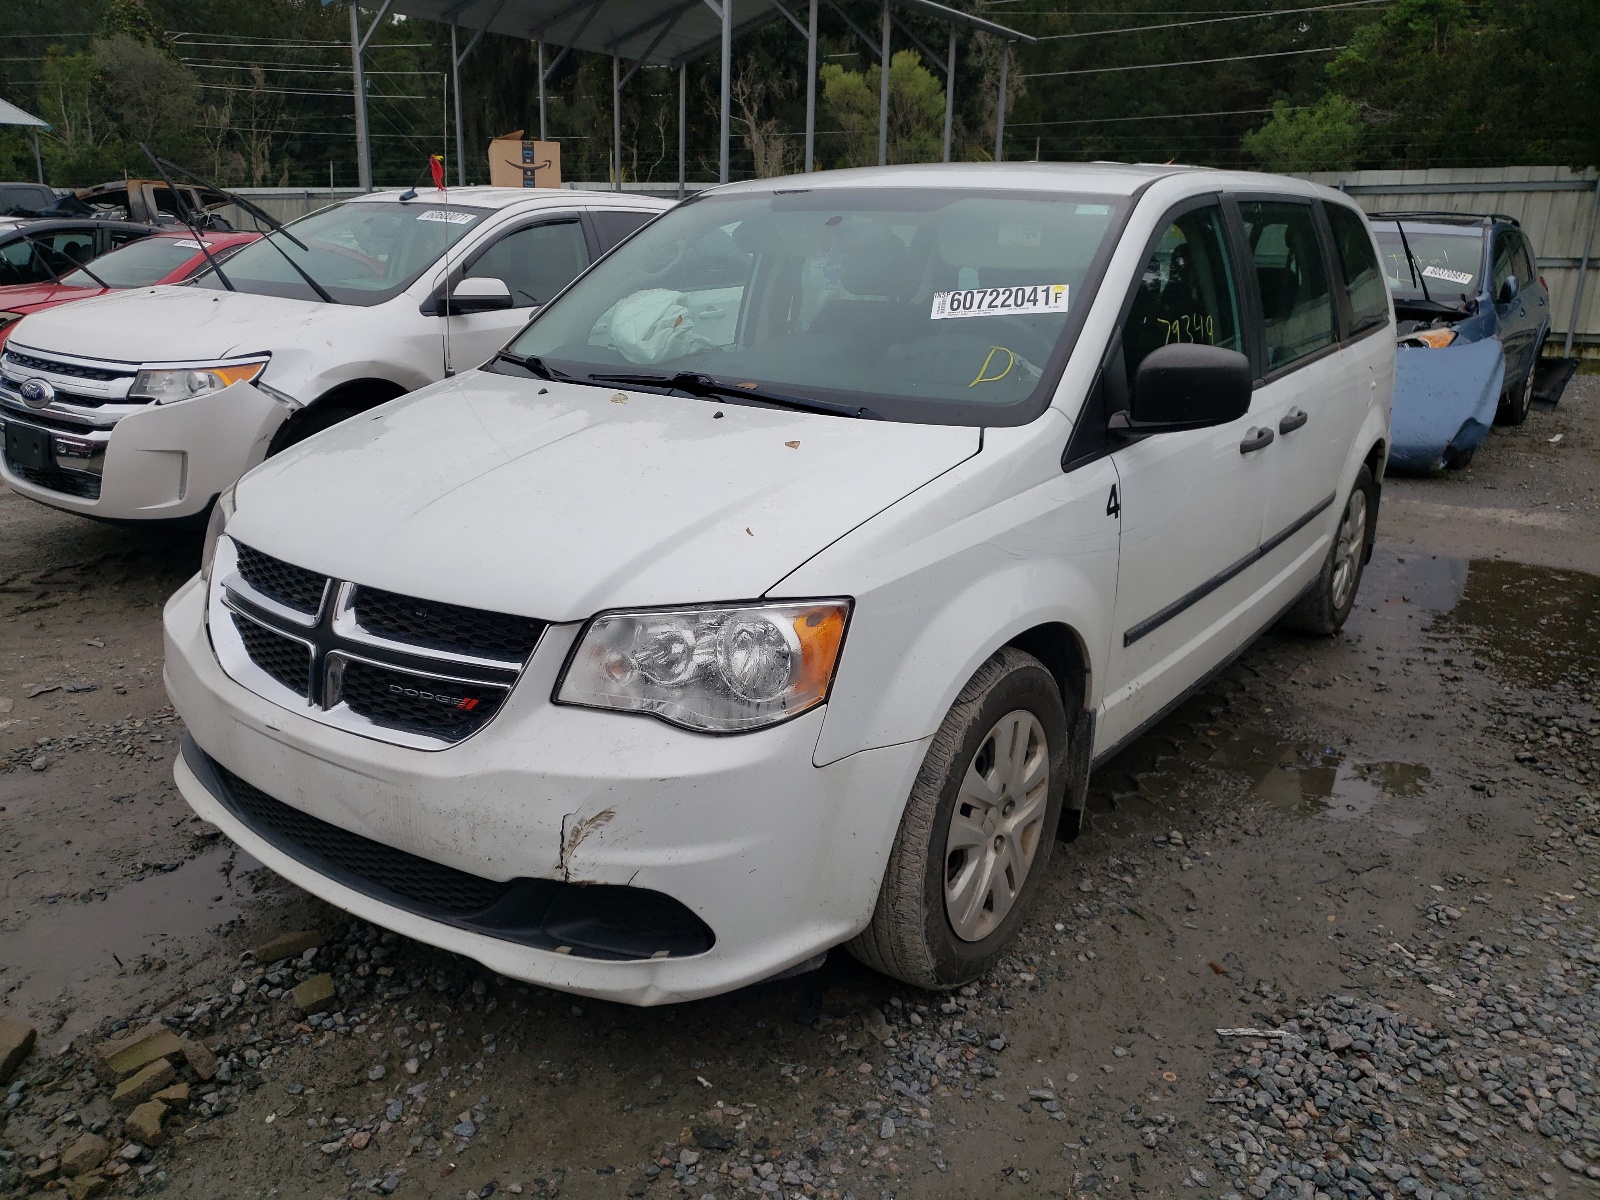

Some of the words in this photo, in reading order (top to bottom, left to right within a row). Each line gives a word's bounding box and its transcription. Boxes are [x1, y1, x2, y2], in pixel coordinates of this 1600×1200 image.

[949, 286, 1051, 311] 60722041
[968, 345, 1015, 388] D
[22, 383, 40, 399] Ford
[1106, 483, 1120, 519] 4
[389, 684, 467, 707] DODGE
